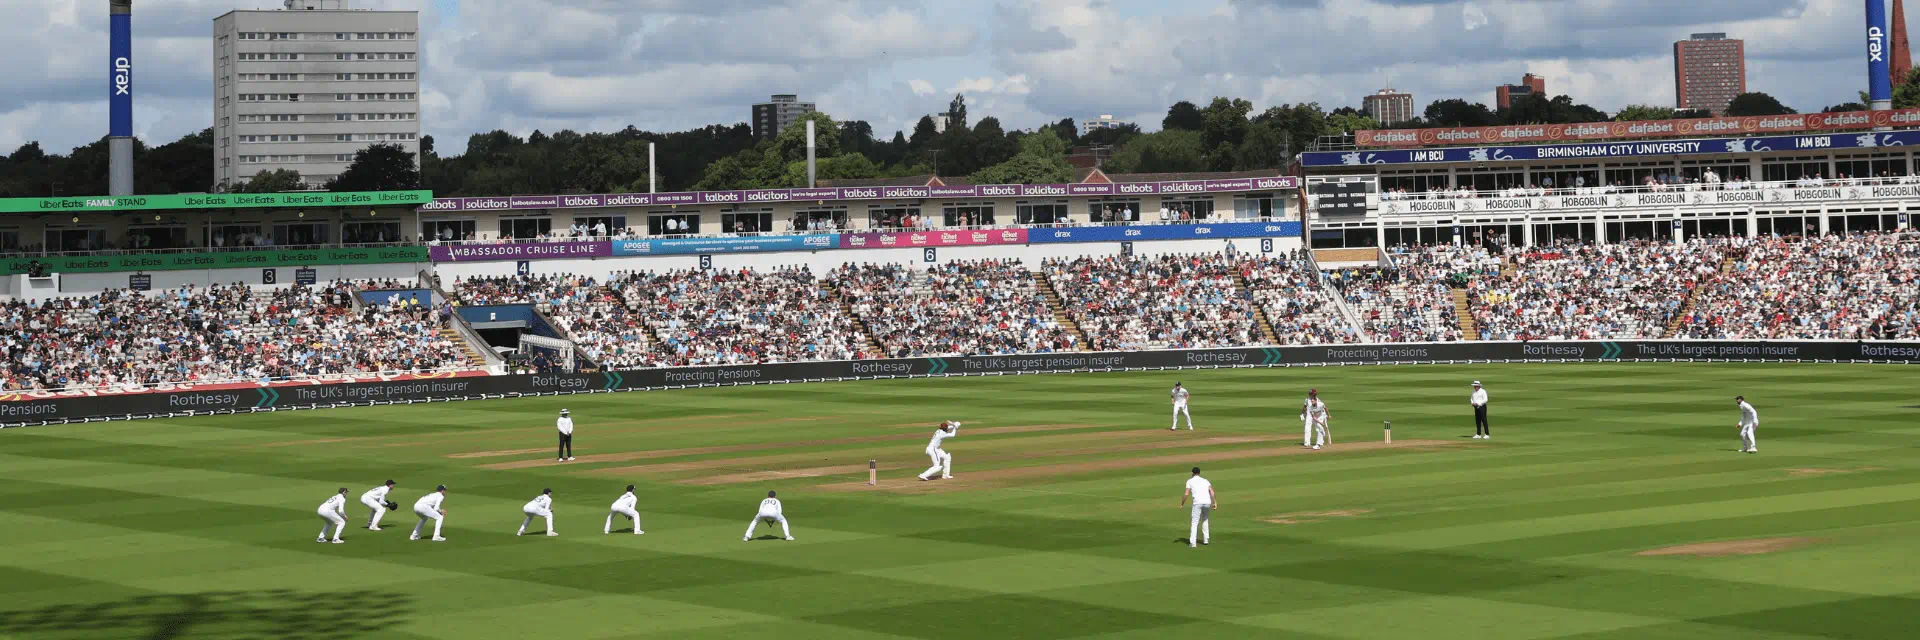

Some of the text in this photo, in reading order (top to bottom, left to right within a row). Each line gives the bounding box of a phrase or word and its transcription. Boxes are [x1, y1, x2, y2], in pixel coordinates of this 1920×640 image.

[1869, 27, 1883, 62] drax
[116, 57, 130, 95] drax
[1373, 132, 1416, 142] dafabet
[1437, 130, 1480, 140] dafabet
[1501, 128, 1543, 138] dafabet
[1564, 126, 1608, 136] dafabet
[1629, 122, 1672, 134] dafabet
[1694, 120, 1739, 131] dafabet
[1760, 117, 1803, 129] dafabet
[1824, 114, 1869, 126] dafabet
[1800, 138, 1812, 147] AM
[1815, 136, 1830, 147] BCU
[1414, 152, 1427, 161] AM
[1428, 151, 1444, 161] BCU
[1537, 142, 1700, 158] BIRMINGHAM CITY UNIVERSITY
[466, 199, 508, 209] solicitors
[565, 196, 598, 206] talbots
[607, 195, 648, 205] solicitors
[705, 193, 738, 202] talbots
[748, 191, 788, 200] solicitors
[844, 188, 877, 198] talbots
[886, 187, 927, 197] solicitors
[983, 186, 1016, 195] talbots
[1024, 185, 1065, 195] solicitors
[1120, 184, 1153, 193] talbots
[1162, 182, 1203, 192] solicitors
[1258, 179, 1290, 188] talbots
[1410, 186, 1920, 212] HOBGOBLIN HOBGOBLIN HOBGOBLIN HOBGOBLIN HOBGOBLIN HOBGOBLIN HOBGOBLIN
[40, 200, 62, 209] Uber
[62, 200, 83, 208] Eats
[1263, 240, 1271, 251] 8
[448, 244, 595, 260] AMBASSADOR CRUISE LINE
[926, 250, 934, 260] 6
[519, 263, 527, 272] 4
[702, 257, 709, 267] 5
[265, 271, 273, 282] 3
[1328, 347, 1427, 360] Protecting Pensions
[1523, 344, 1585, 356] Rothesay
[1637, 344, 1798, 356] The UK's largest pension insurer
[1861, 344, 1920, 358] Rothesay
[963, 356, 1124, 369] The UK's largest pension insurer
[1187, 352, 1246, 364] Rothesay
[853, 362, 913, 373] Rothesay
[666, 371, 715, 383] Protecting
[718, 368, 760, 379] Pensions
[533, 376, 589, 388] Rothesay
[296, 381, 468, 399] The UK's largest pension insurer
[170, 394, 239, 406] Rothesay
[1, 402, 56, 416] Pensions
